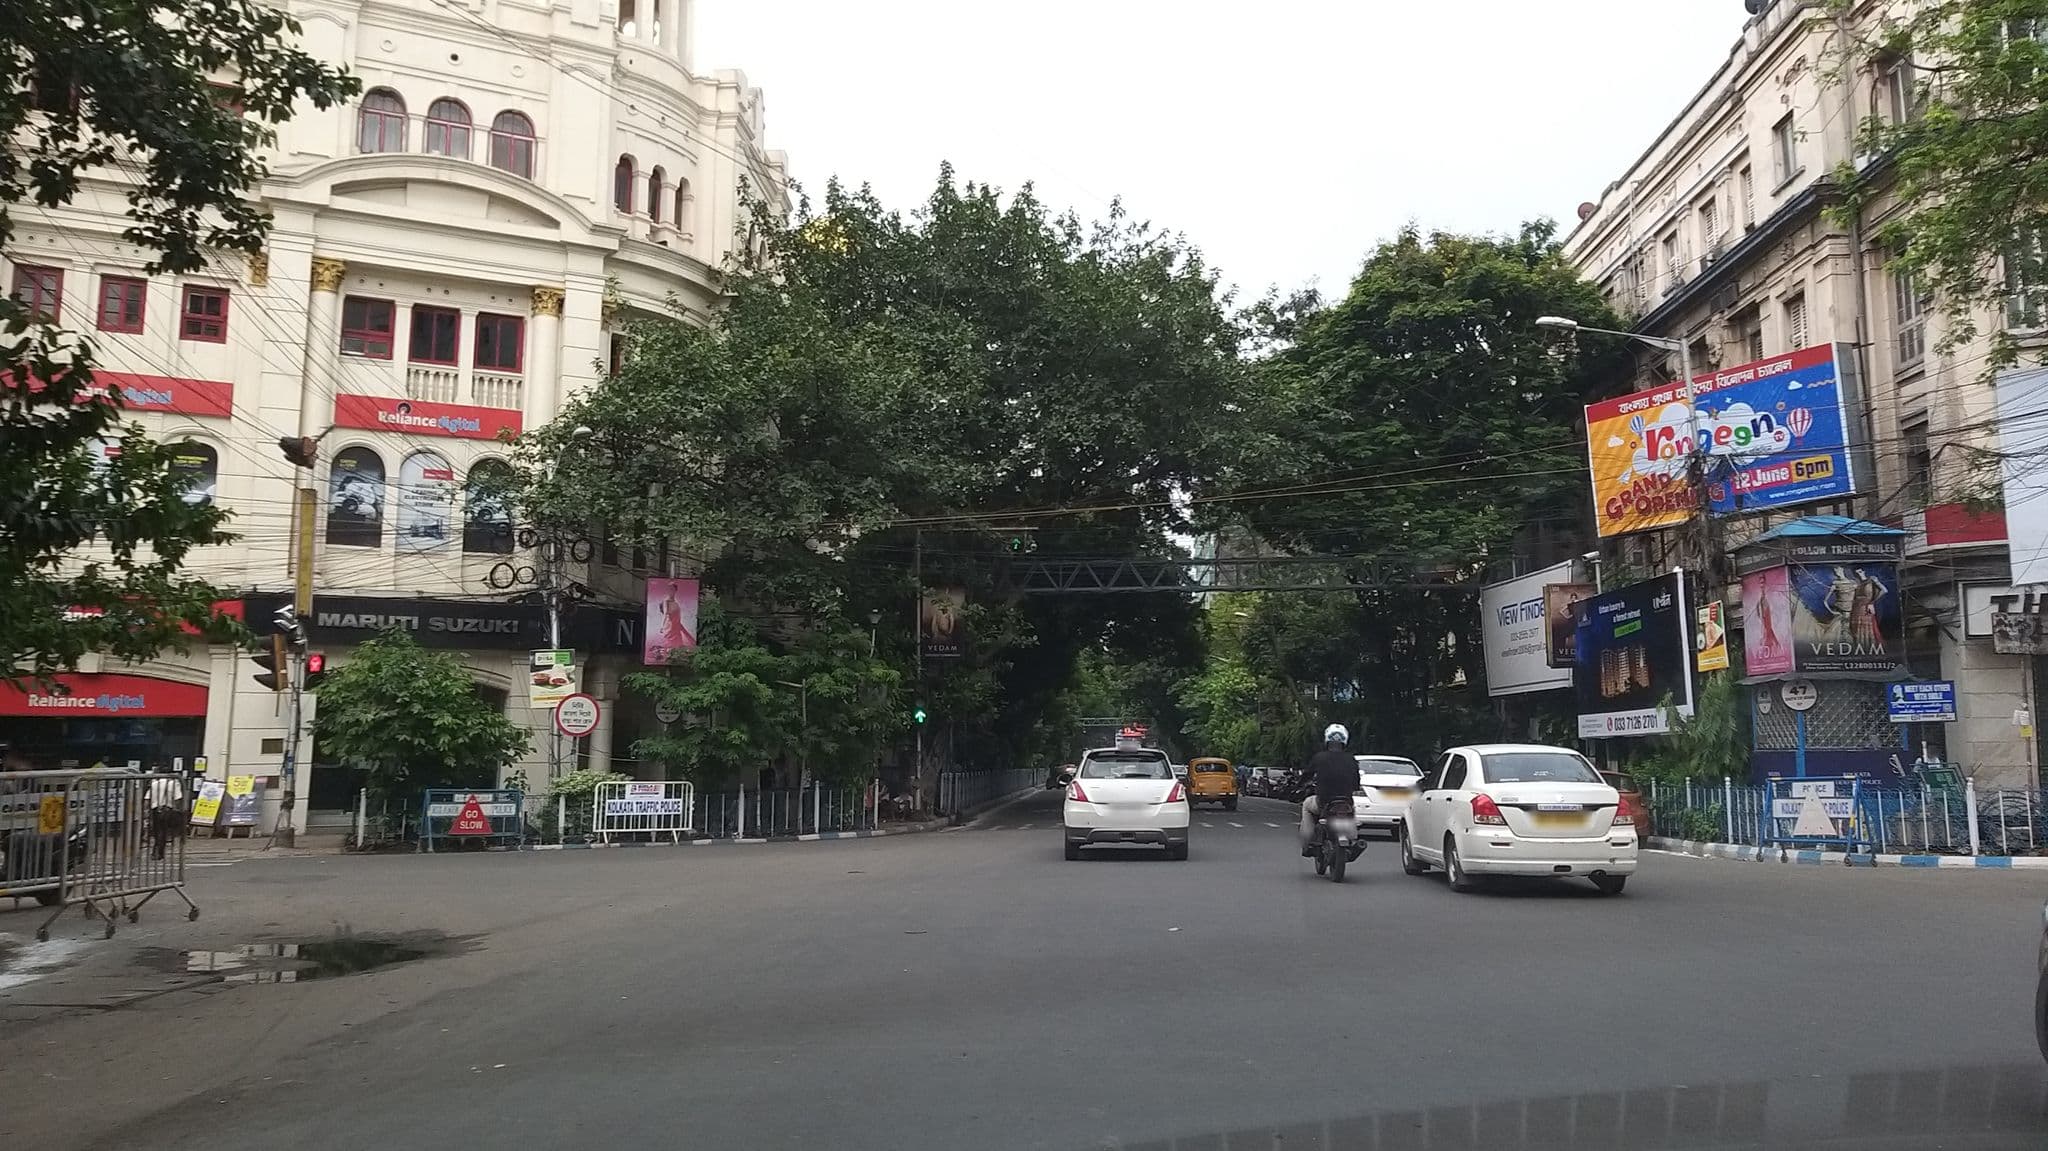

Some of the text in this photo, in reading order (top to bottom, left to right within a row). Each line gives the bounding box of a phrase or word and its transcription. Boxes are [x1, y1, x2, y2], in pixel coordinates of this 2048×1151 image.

[1716, 369, 1754, 390] বিনোদন
[1758, 357, 1793, 378] চ্যানেল
[378, 410, 480, 432] Reliance digital
[1752, 467, 1789, 487] June
[1795, 460, 1829, 478] 6pm
[1606, 472, 1672, 521] GRAND
[1634, 483, 1725, 516] OPENIG
[1792, 543, 1896, 555] FOLLOW TRAFFIC RULES
[1497, 597, 1545, 627] VIEW FINDE
[318, 613, 519, 633] MARUTI SUZUKI
[927, 644, 958, 652] VEDAM
[1811, 643, 1885, 656] VEDAM
[1790, 686, 1808, 695] 47
[28, 691, 145, 711] Reliance digital
[1614, 717, 1626, 731] 033
[1626, 715, 1641, 730] 7126
[1643, 714, 1658, 728] 2701
[465, 810, 478, 819] GO
[608, 800, 681, 813] KOLKATA TRAFFIC POLICE
[459, 820, 483, 830] SLOW
